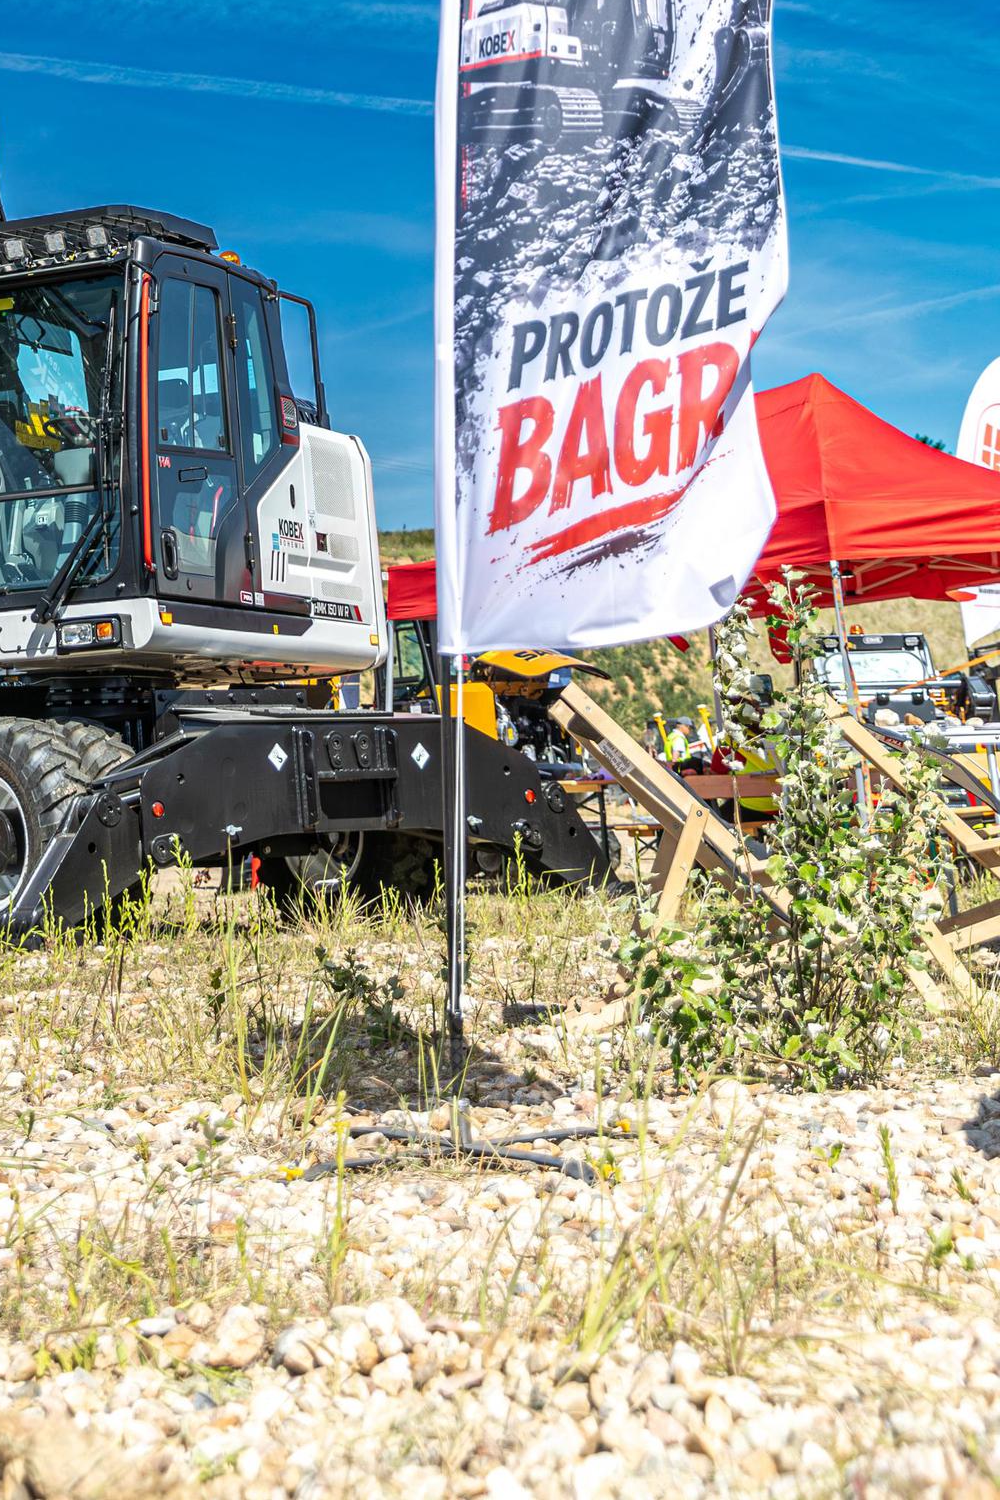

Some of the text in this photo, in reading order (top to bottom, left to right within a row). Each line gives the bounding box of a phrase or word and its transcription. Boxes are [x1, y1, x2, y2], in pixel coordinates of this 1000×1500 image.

[479, 29, 516, 59] KOBEX
[506, 255, 750, 393] PROTOŽE
[278, 518, 304, 541] KOBEX
[279, 541, 305, 550] BOHEMIA
[314, 603, 327, 616] HMK
[327, 604, 338, 617] 150
